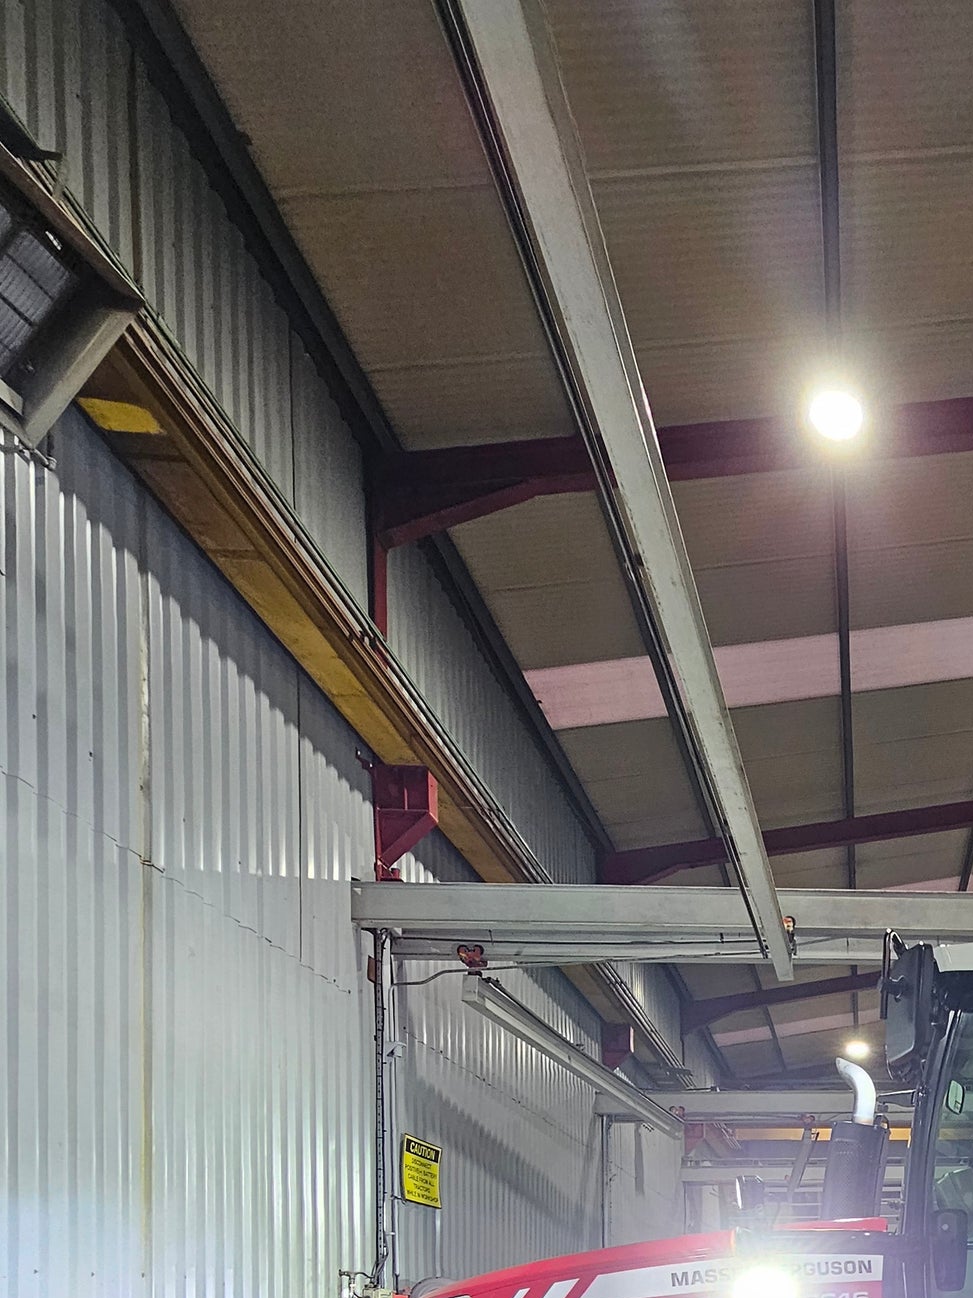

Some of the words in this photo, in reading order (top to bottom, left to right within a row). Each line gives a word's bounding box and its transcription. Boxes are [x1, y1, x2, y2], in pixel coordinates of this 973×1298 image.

[410, 1142, 435, 1160] CAUTION
[671, 1266, 739, 1287] MASS
[781, 1259, 872, 1277] RGUSON
